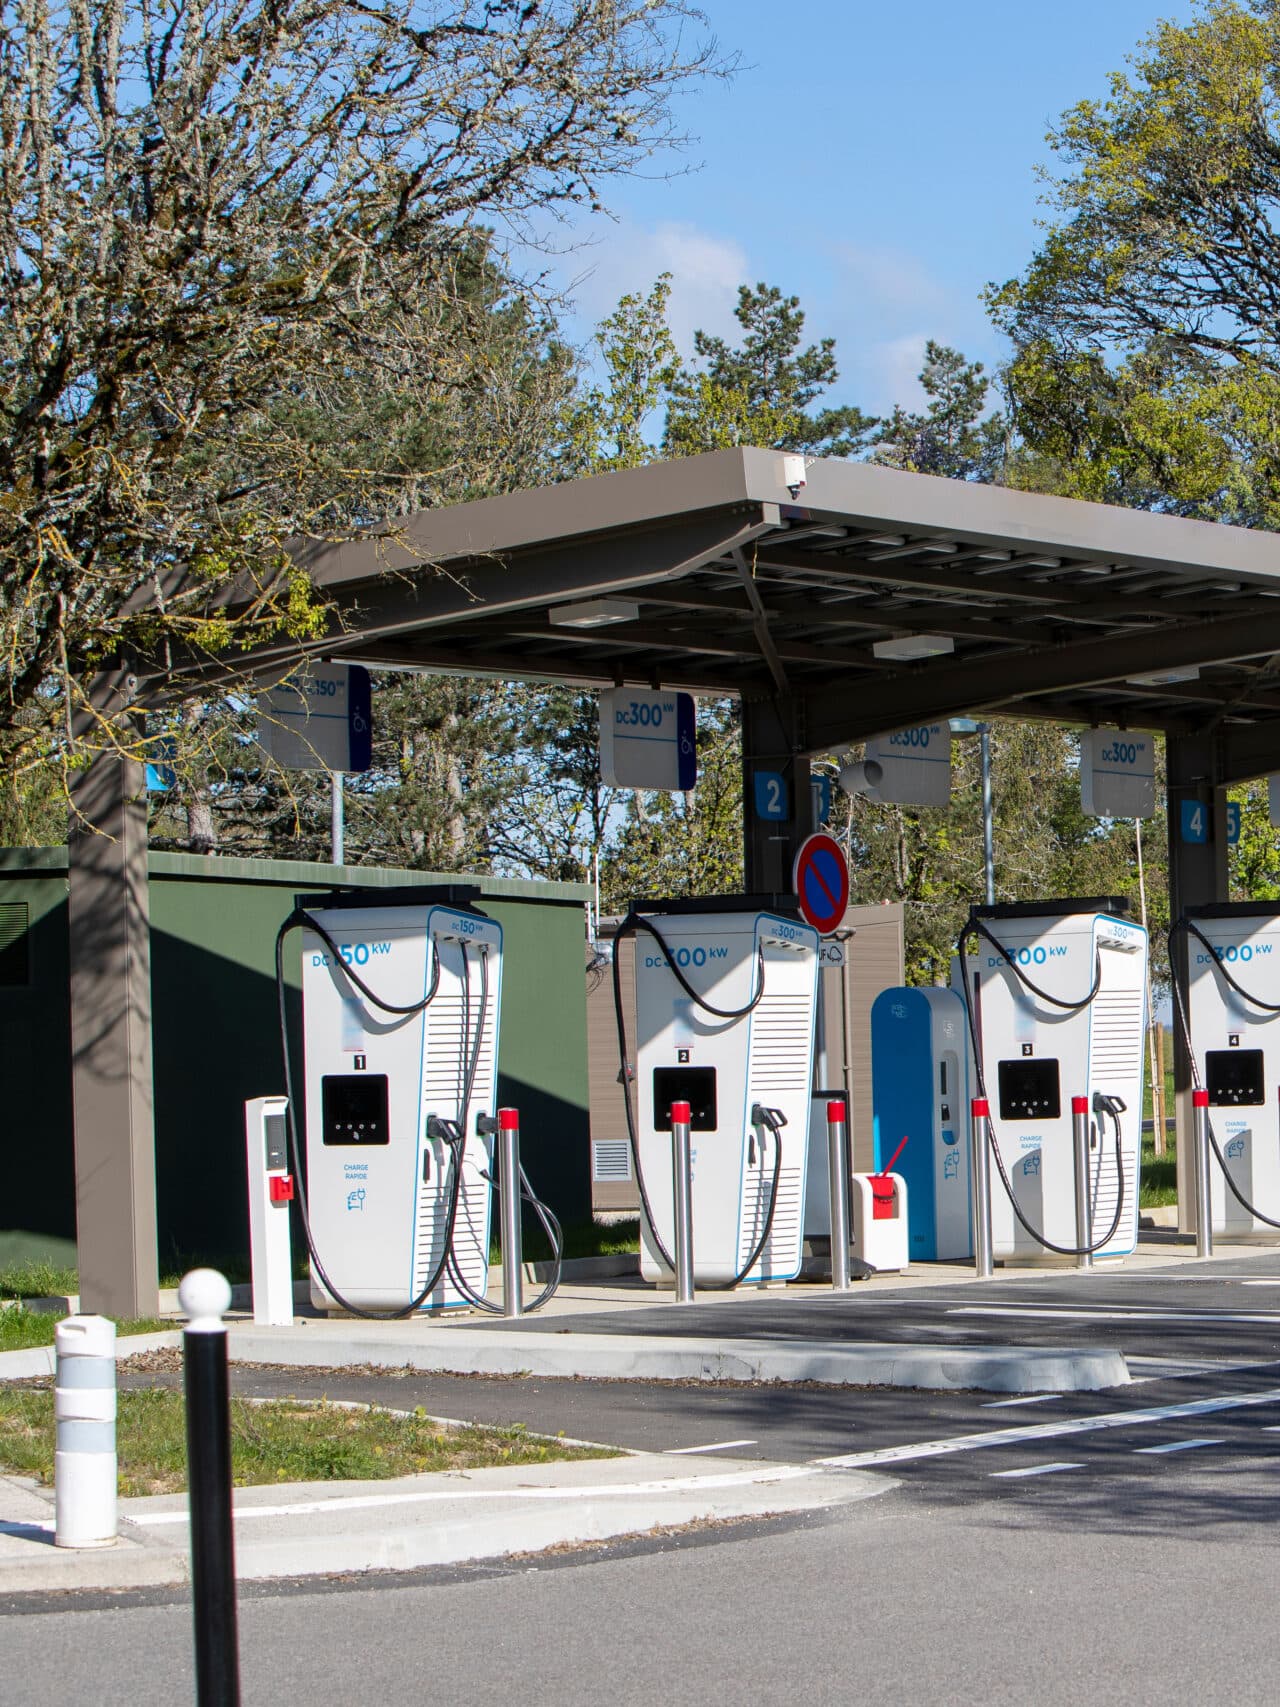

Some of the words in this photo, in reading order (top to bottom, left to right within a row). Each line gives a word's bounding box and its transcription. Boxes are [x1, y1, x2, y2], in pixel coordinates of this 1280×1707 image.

[766, 779, 782, 813] 2
[1189, 807, 1203, 837] 4
[1226, 808, 1236, 838] 5
[459, 919, 475, 935] 150
[777, 925, 795, 940] 300
[312, 955, 330, 967] DC
[371, 942, 392, 955] kW
[645, 957, 662, 968] DC
[709, 947, 729, 958] kW
[987, 957, 1004, 968] DC
[1049, 946, 1068, 957] kW
[1196, 954, 1212, 964] DC
[1255, 944, 1273, 954] kW
[1231, 1036, 1237, 1045] 4
[680, 1051, 687, 1061] 2
[1024, 1045, 1031, 1055] 3
[356, 1055, 363, 1069] 1
[343, 1163, 369, 1171] CHARGE
[345, 1172, 368, 1180] RAPIDE
